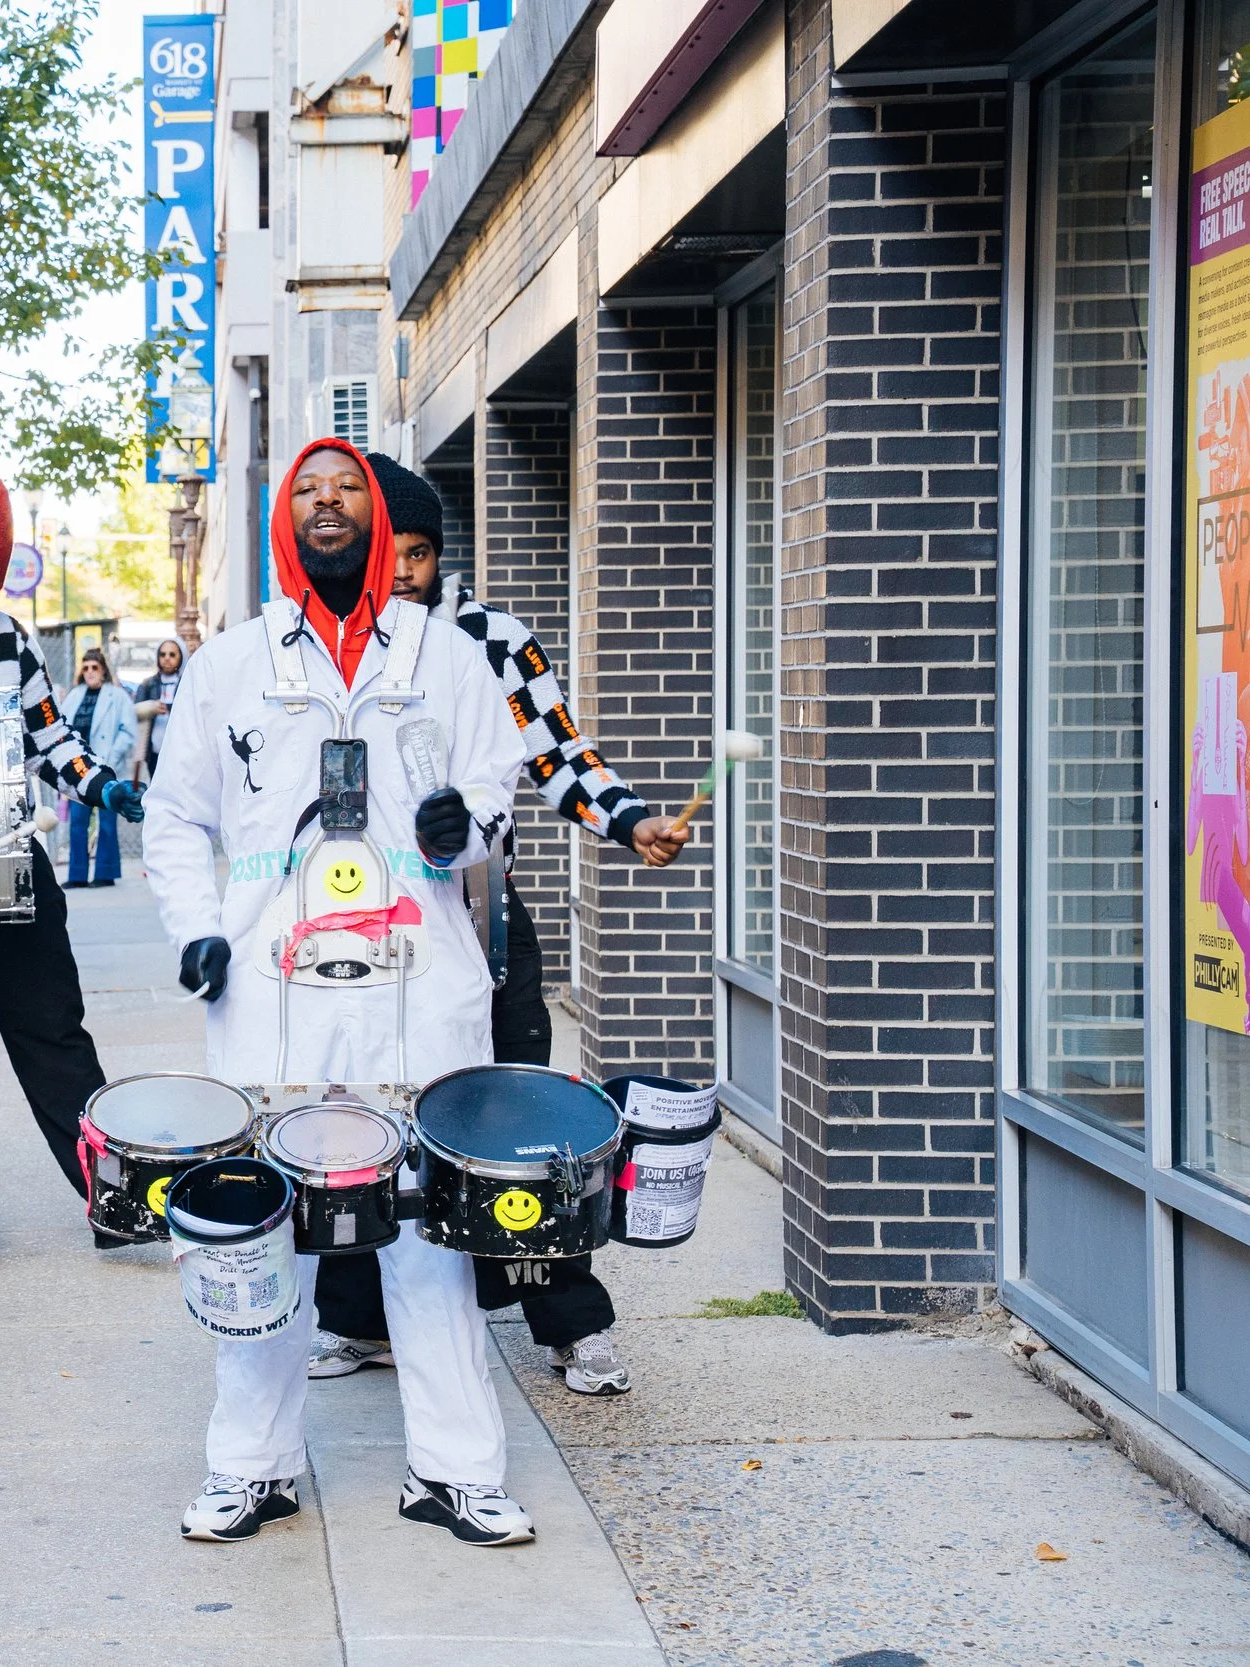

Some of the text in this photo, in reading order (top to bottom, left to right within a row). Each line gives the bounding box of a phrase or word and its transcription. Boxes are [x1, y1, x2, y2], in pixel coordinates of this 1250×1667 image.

[150, 38, 207, 79] 618
[152, 83, 201, 100] Garage
[1200, 176, 1221, 215] FREE
[1200, 200, 1246, 250] REAL TALK.
[525, 646, 545, 674] LIFE
[1198, 934, 1234, 950] PRESENTED BY
[651, 1102, 710, 1114] ENTERTAINMENT
[656, 1096, 692, 1105] POSITIVE
[640, 1168, 666, 1180] JOIN
[670, 1168, 686, 1180] US!
[656, 1182, 681, 1190] MUSICAL
[203, 1248, 220, 1258] want
[234, 1248, 260, 1257] Donate
[236, 1252, 268, 1266] Movement
[220, 1266, 260, 1274] Drill Team
[504, 1260, 550, 1286] VIC
[200, 1316, 208, 1326] U
[210, 1321, 262, 1336] ROCKIN
[266, 1312, 289, 1332] WIT
